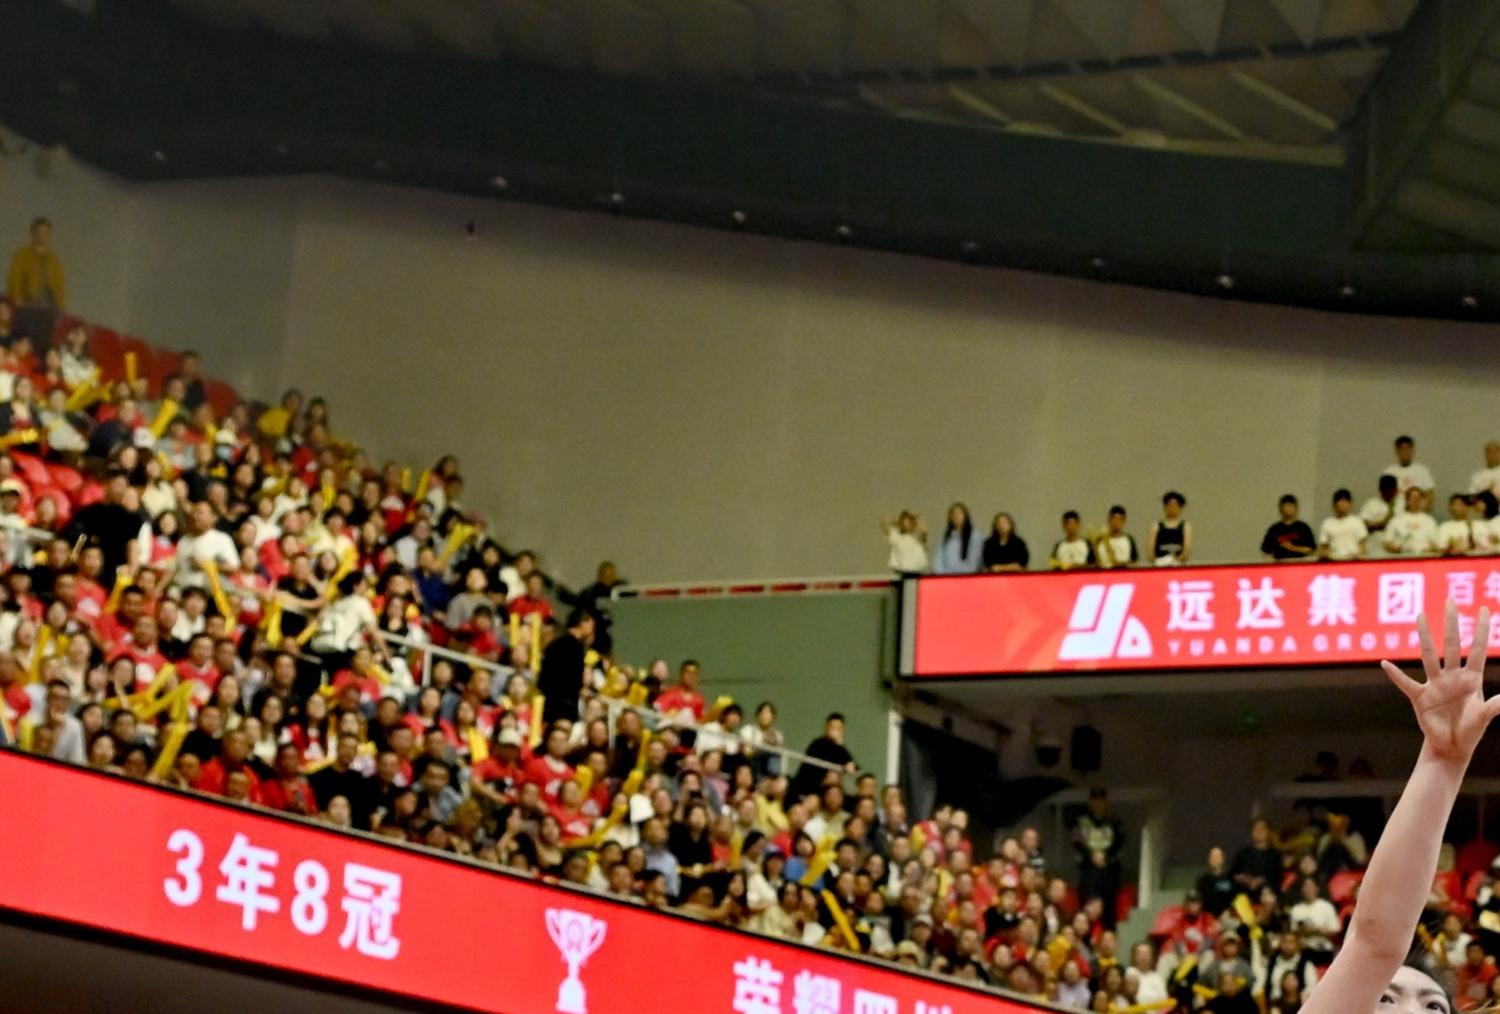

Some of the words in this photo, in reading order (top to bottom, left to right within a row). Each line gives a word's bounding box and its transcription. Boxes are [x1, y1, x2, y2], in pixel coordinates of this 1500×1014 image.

[1166, 571, 1425, 632] 远达集团
[1168, 634, 1298, 657] YUANDA
[1312, 630, 1420, 654] GROUP
[164, 828, 403, 960] 3年8冠
